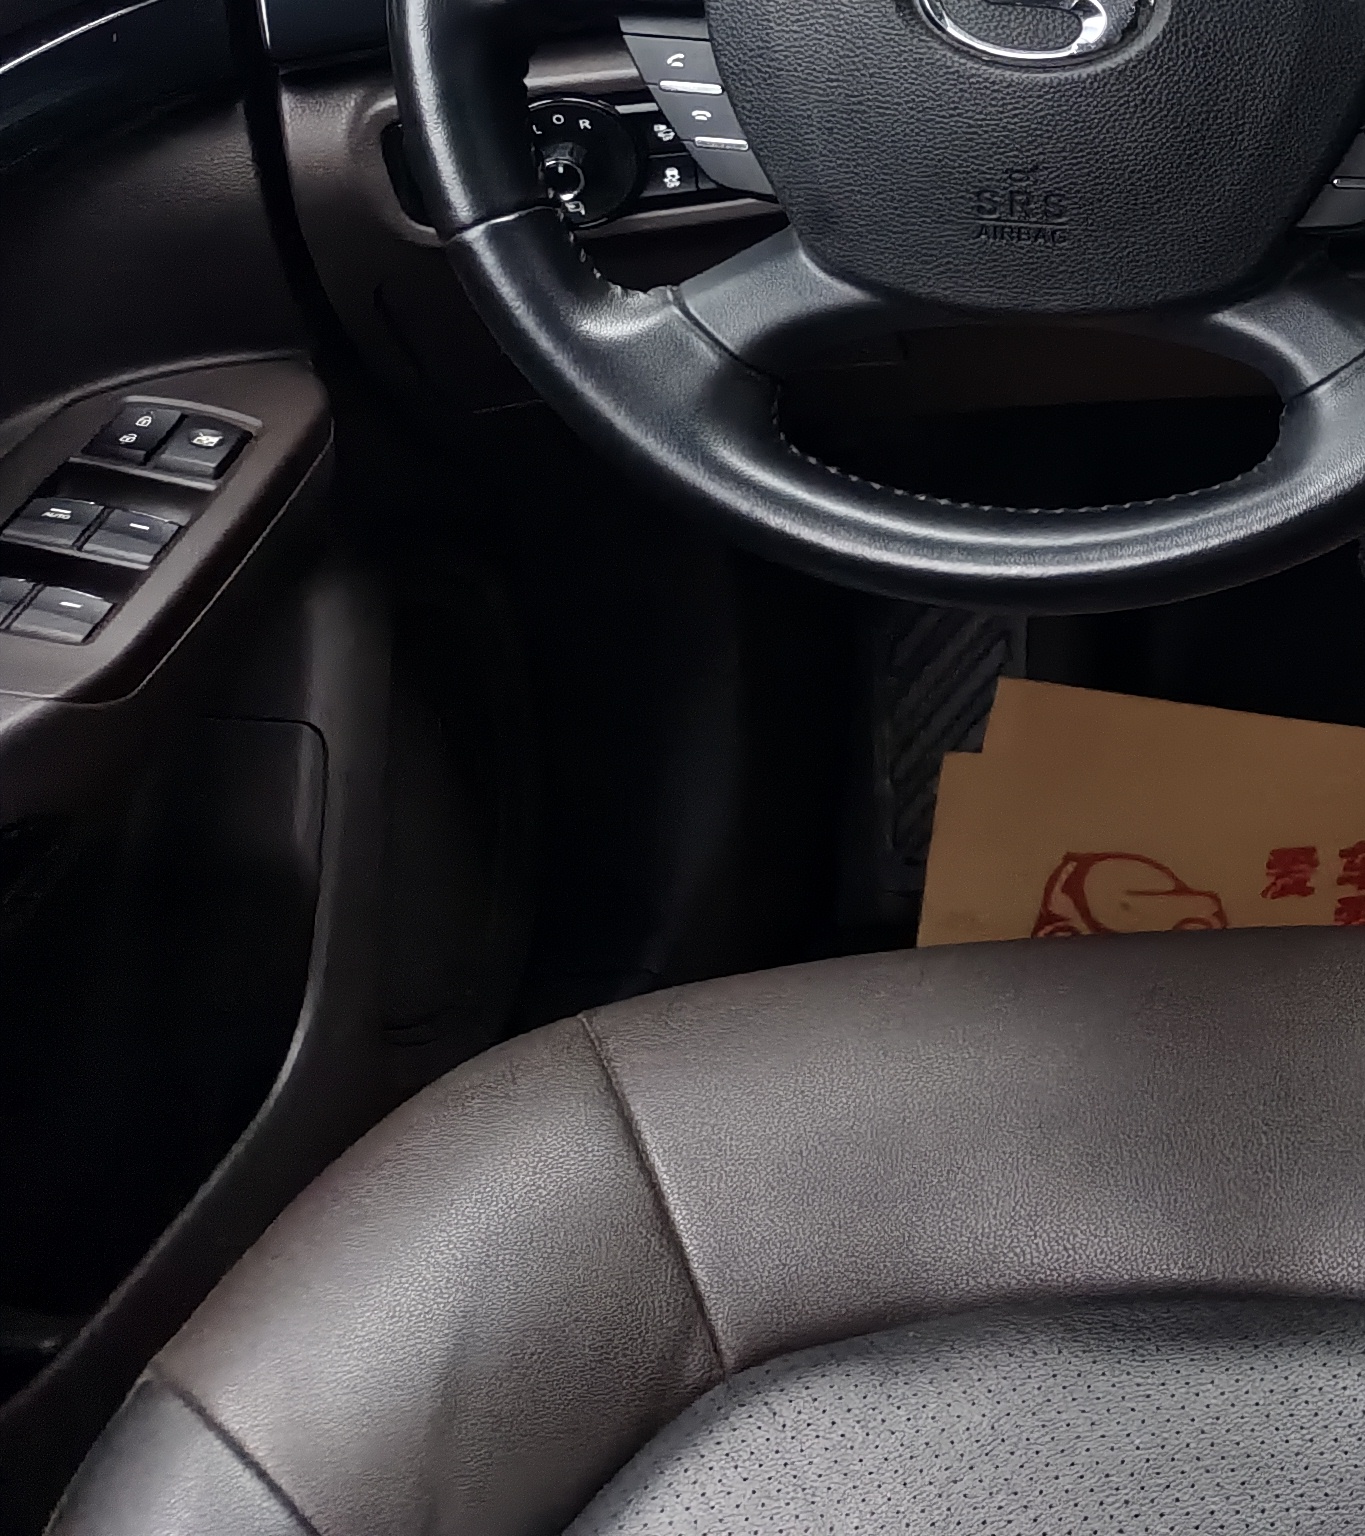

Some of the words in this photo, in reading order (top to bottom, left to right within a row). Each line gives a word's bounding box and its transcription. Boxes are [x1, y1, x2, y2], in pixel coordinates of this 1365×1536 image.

[578, 118, 592, 130] R
[976, 189, 1067, 220] SRS
[977, 223, 1067, 243] AIRBAG
[41, 511, 71, 520] AUTO
